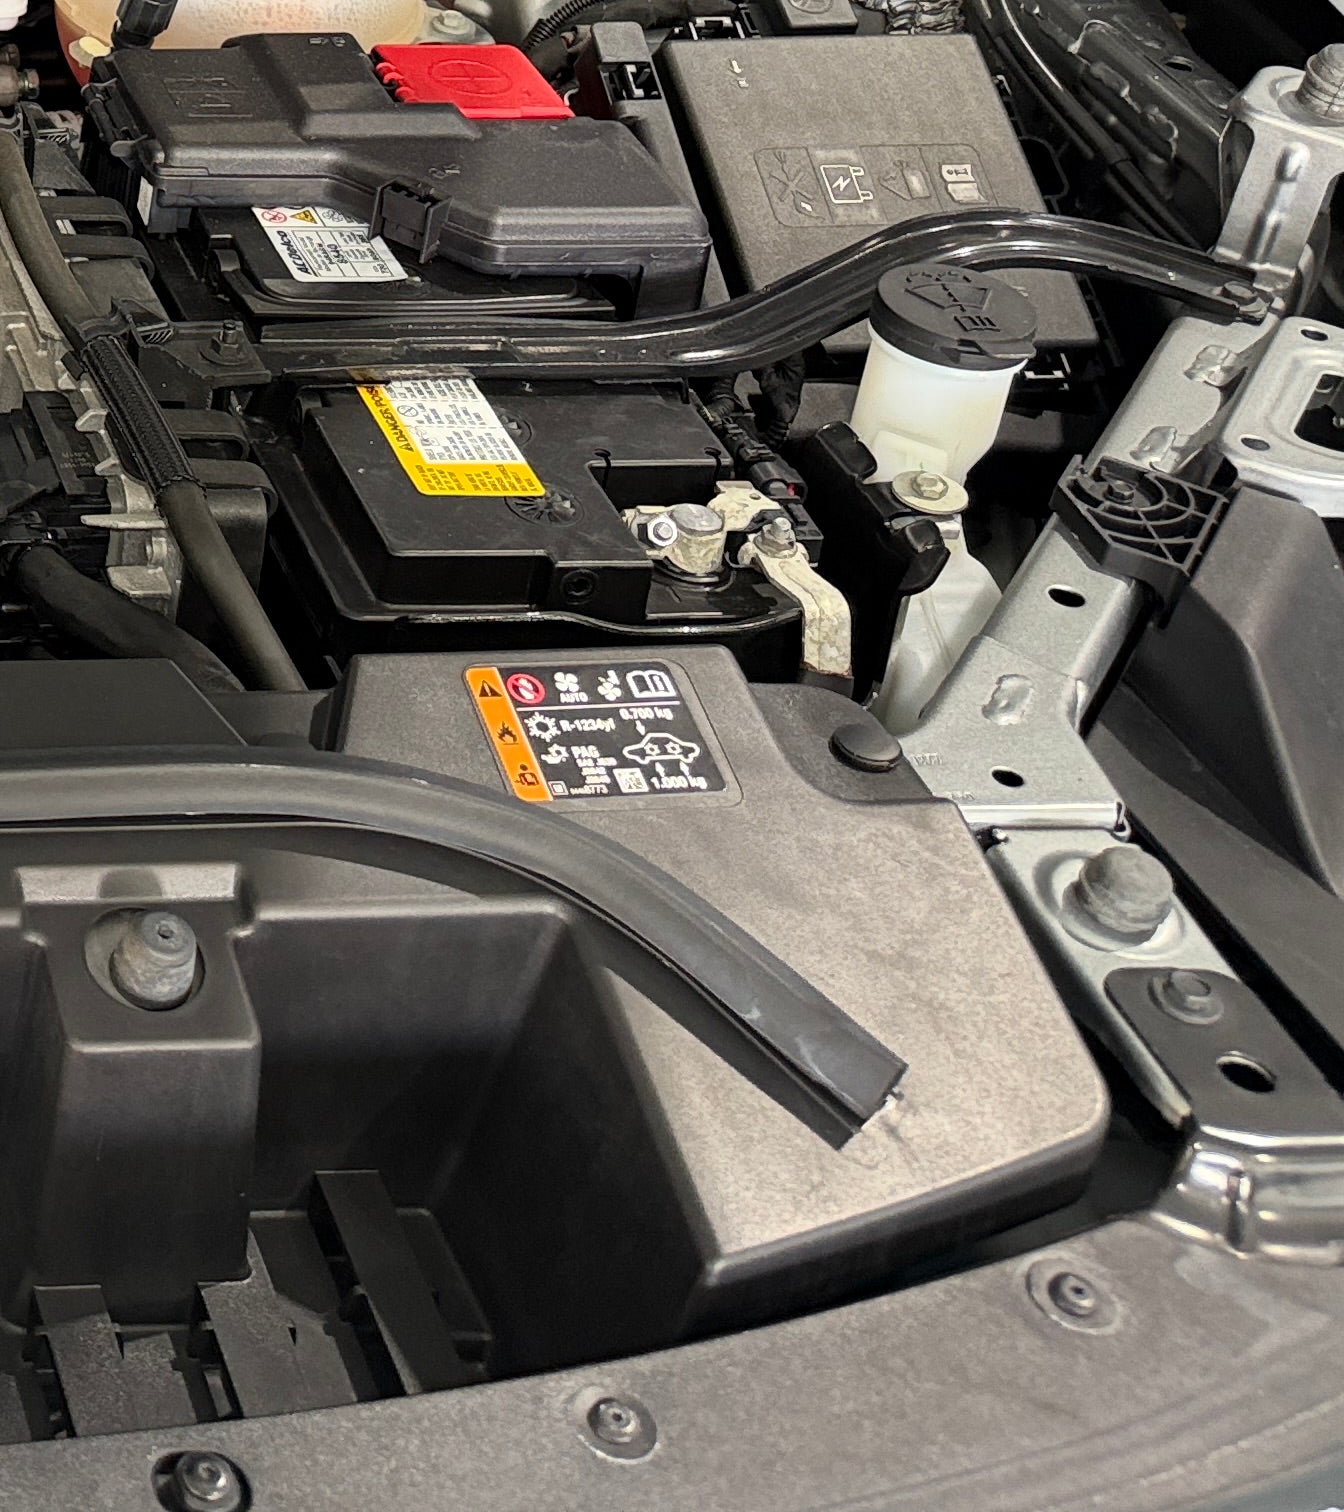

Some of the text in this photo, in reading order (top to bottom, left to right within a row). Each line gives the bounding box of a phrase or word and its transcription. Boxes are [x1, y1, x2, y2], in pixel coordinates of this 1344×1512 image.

[275, 230, 313, 276] ACDelco
[379, 407, 409, 443] DANGER
[559, 691, 589, 703] AUTO
[619, 706, 674, 721] 0.700 kg
[570, 744, 601, 759] PAG
[650, 775, 708, 790] 1.000 kg
